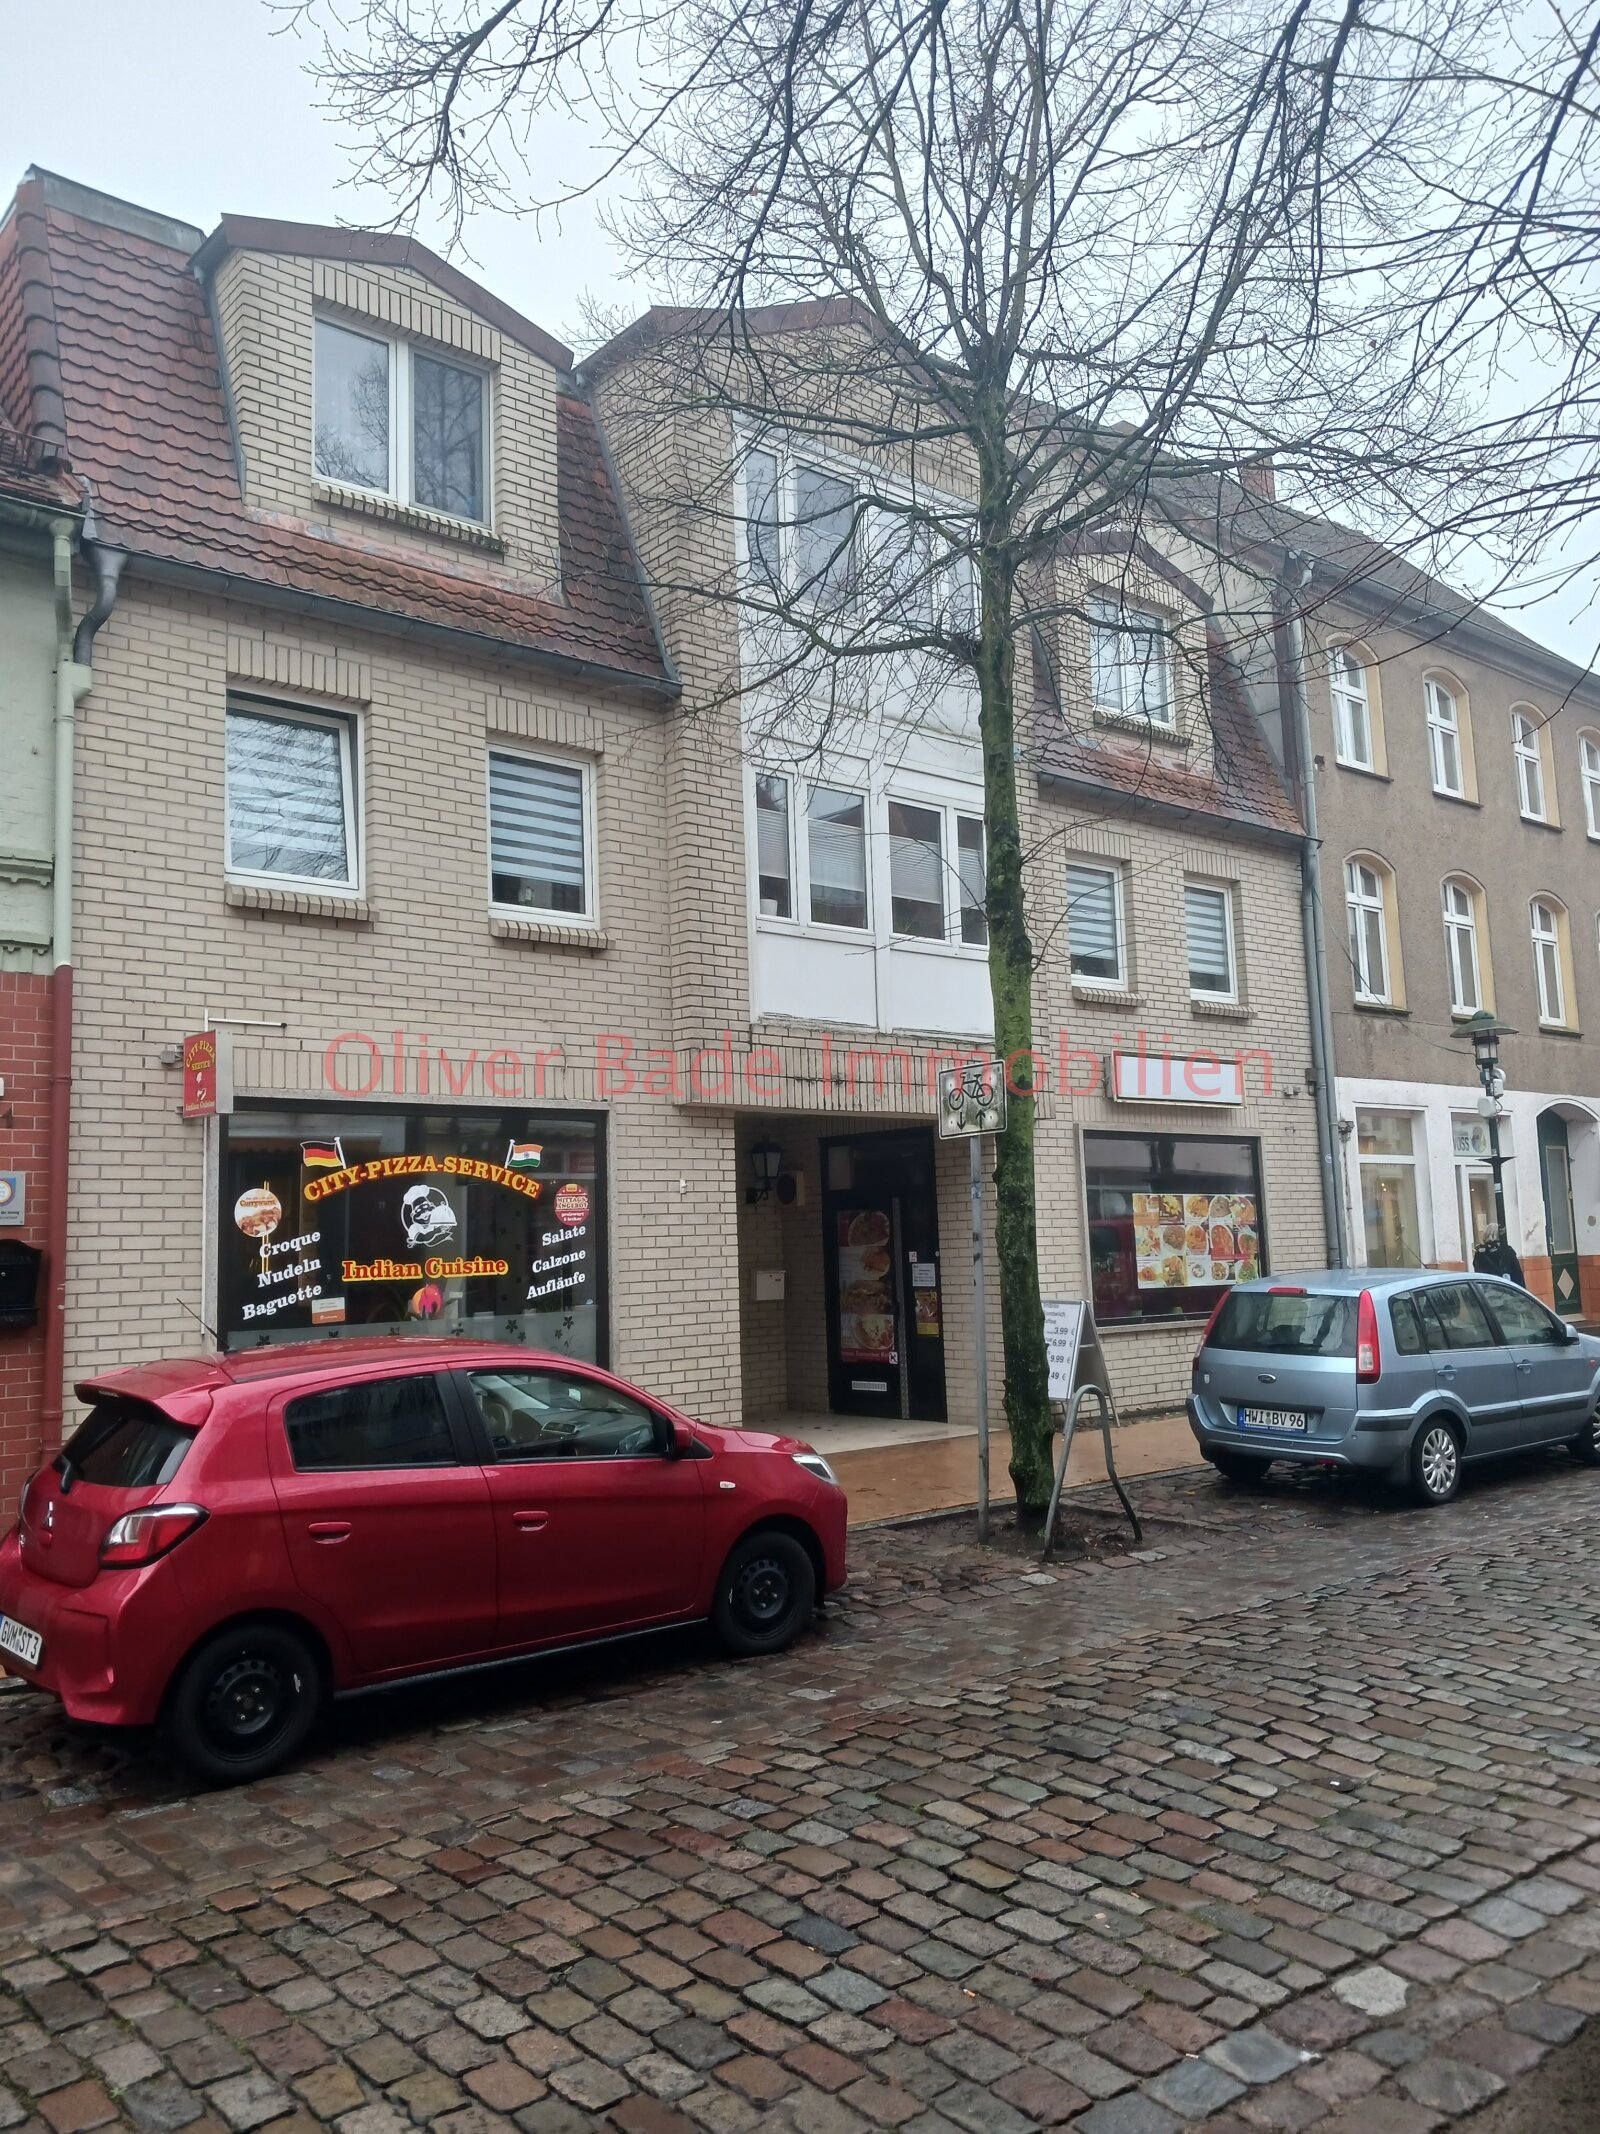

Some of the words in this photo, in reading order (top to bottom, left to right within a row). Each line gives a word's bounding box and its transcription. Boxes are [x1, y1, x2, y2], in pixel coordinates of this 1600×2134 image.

[191, 1060, 210, 1071] SERVICE
[304, 1155, 542, 1201] CITY-PIZZA-SERVICE
[259, 1231, 321, 1258] Croque
[541, 1225, 586, 1246] Salate
[257, 1258, 322, 1288] Nudeln
[342, 1259, 423, 1281] Indian
[424, 1256, 508, 1278] Cuisine
[532, 1249, 586, 1273] Calzone
[526, 1271, 586, 1300] Aufläufe
[242, 1285, 322, 1320] Baguette
[1244, 1409, 1264, 1424] HWI
[1272, 1412, 1287, 1425] BV
[1289, 1414, 1304, 1428] 96
[1, 1620, 18, 1648] GVM
[19, 1631, 32, 1655] ST
[31, 1636, 39, 1659] 3
